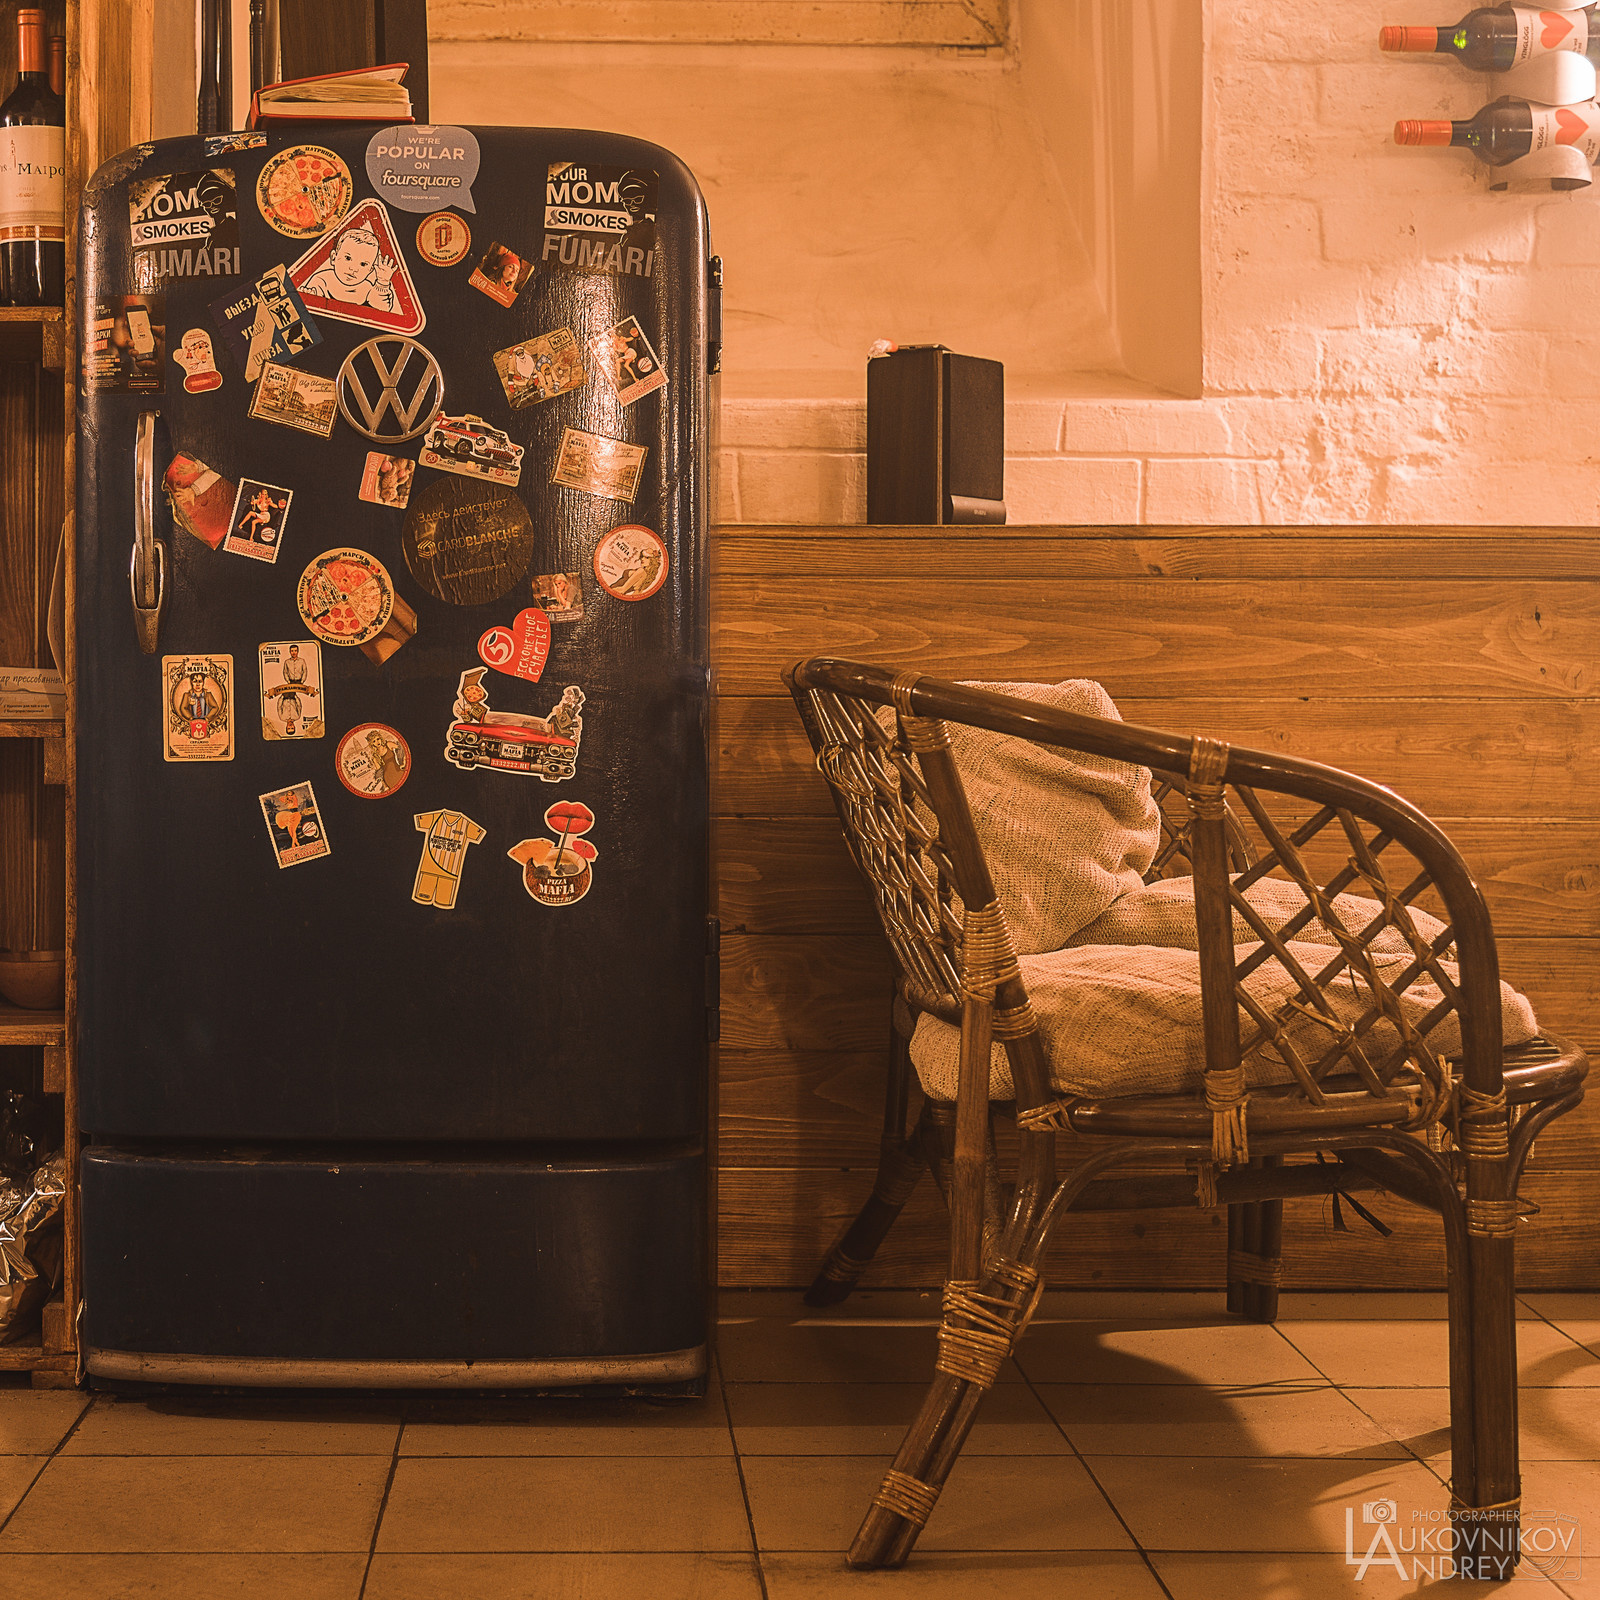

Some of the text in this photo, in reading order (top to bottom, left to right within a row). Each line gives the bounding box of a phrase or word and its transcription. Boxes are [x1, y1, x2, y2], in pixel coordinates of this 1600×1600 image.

[408, 137, 441, 145] WE'RE
[376, 145, 465, 161] POPULAR
[414, 162, 430, 170] ON
[381, 169, 462, 191] foursquare
[546, 181, 619, 205] MOM
[143, 220, 210, 239] SMOKES
[557, 210, 628, 231] SMOKES
[541, 233, 654, 278] FUMARI
[241, 320, 265, 341] УГАР
[417, 498, 508, 524] Здесь действует
[437, 525, 520, 552] CARDBLANCHE
[514, 612, 536, 678] БЕСКОНЕЧНОЕ
[528, 620, 548, 676] СЧАСТЬЕ!
[504, 747, 521, 755] MAFIA
[539, 883, 575, 895] MAFIA
